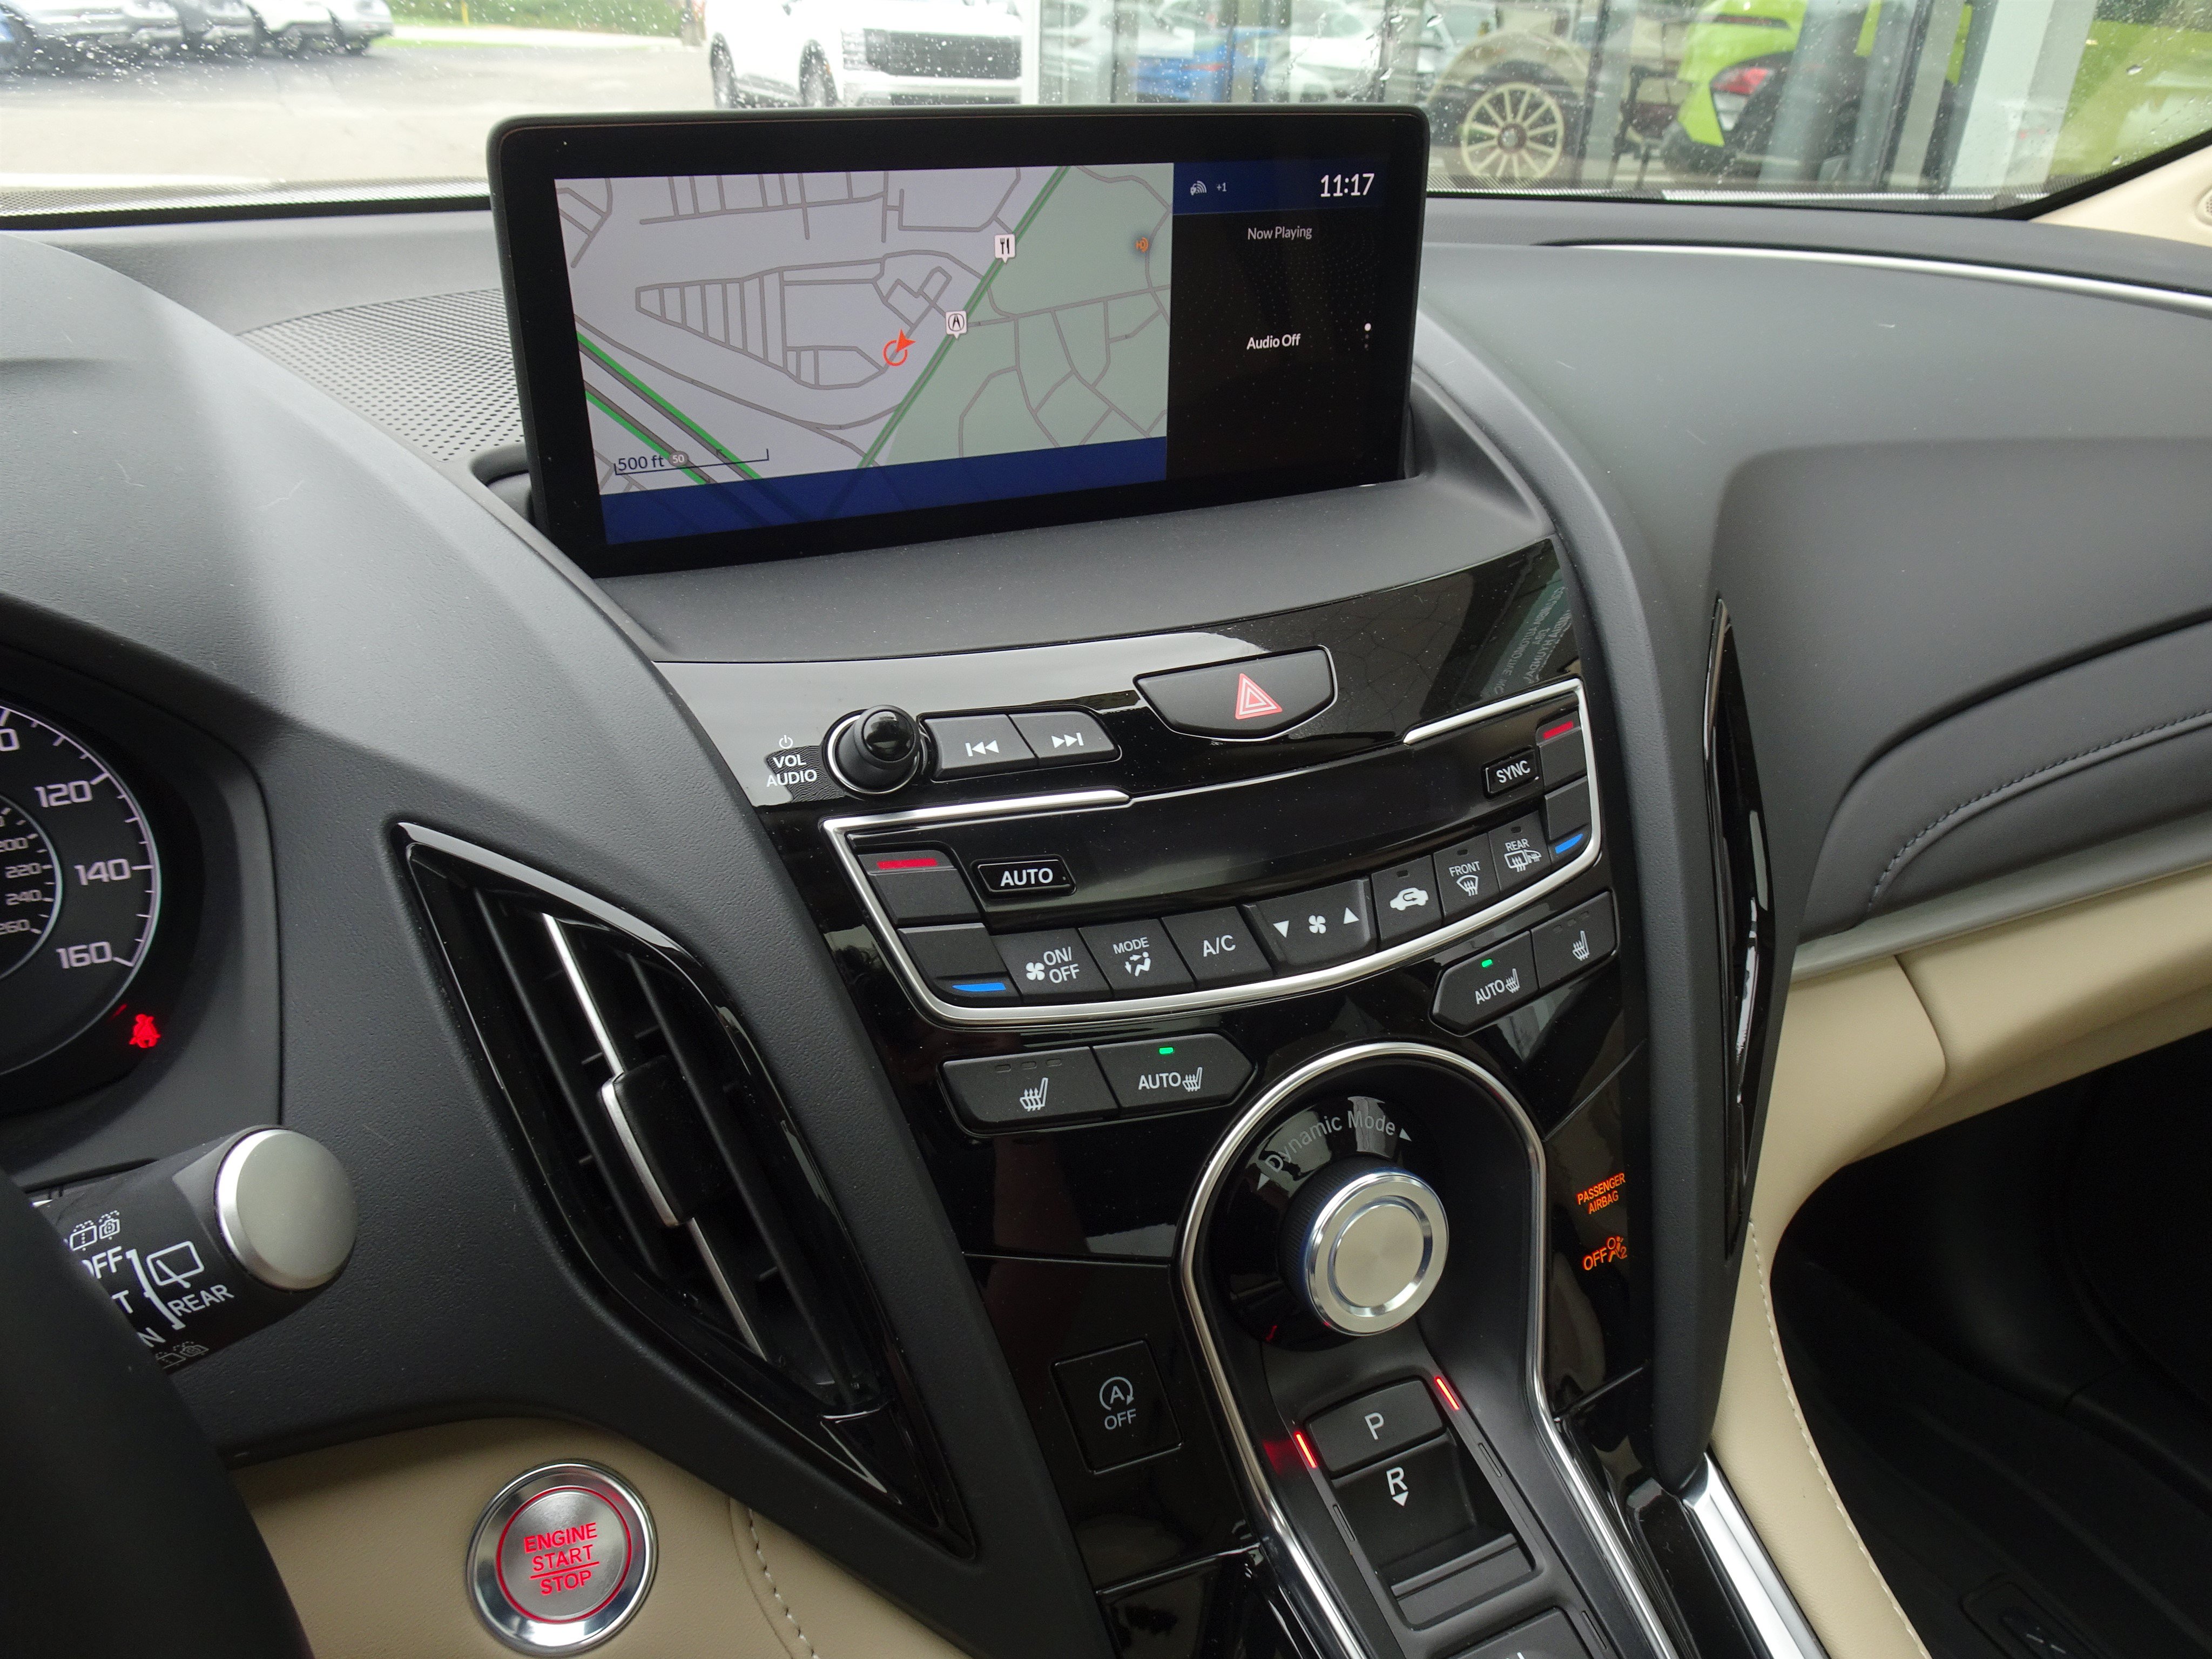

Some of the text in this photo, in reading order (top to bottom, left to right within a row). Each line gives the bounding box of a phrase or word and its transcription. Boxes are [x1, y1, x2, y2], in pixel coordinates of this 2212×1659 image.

[1216, 182, 1227, 192] +1
[1320, 173, 1375, 198] 11:17
[1247, 226, 1312, 240] Now Playing
[1246, 333, 1301, 350] Audio Off
[618, 455, 664, 471] 500 ft
[772, 754, 807, 768] VOL
[1495, 760, 1530, 784] SYNC
[766, 769, 818, 787] AUDIO
[34, 780, 93, 807] 120
[1505, 838, 1530, 852] REAR
[5, 862, 42, 879] 220
[74, 858, 131, 885] 140
[1000, 867, 1054, 887] AUTO
[1448, 861, 1481, 878] FRONT
[5, 889, 42, 906] 240
[56, 941, 112, 969] 160
[1043, 946, 1072, 966] ON/
[1113, 937, 1150, 954] MODE
[1202, 934, 1236, 957] A/C
[1049, 963, 1080, 983] OFF
[1475, 979, 1505, 1005] AUTO
[1138, 1072, 1181, 1090] AUTO
[1264, 1110, 1396, 1173] Dynamic Mode
[1576, 1172, 1626, 1205] PASSENGER
[1588, 1190, 1619, 1215] AIRBAG
[1582, 1246, 1608, 1271] OFF
[167, 1284, 234, 1316] REAR
[137, 1327, 165, 1347] N
[1104, 1408, 1136, 1430] OFF
[1364, 1412, 1384, 1440] P
[1386, 1467, 1408, 1496] R
[523, 1522, 597, 1554] ENGINE
[531, 1544, 594, 1573] START
[540, 1570, 592, 1595] STOP
